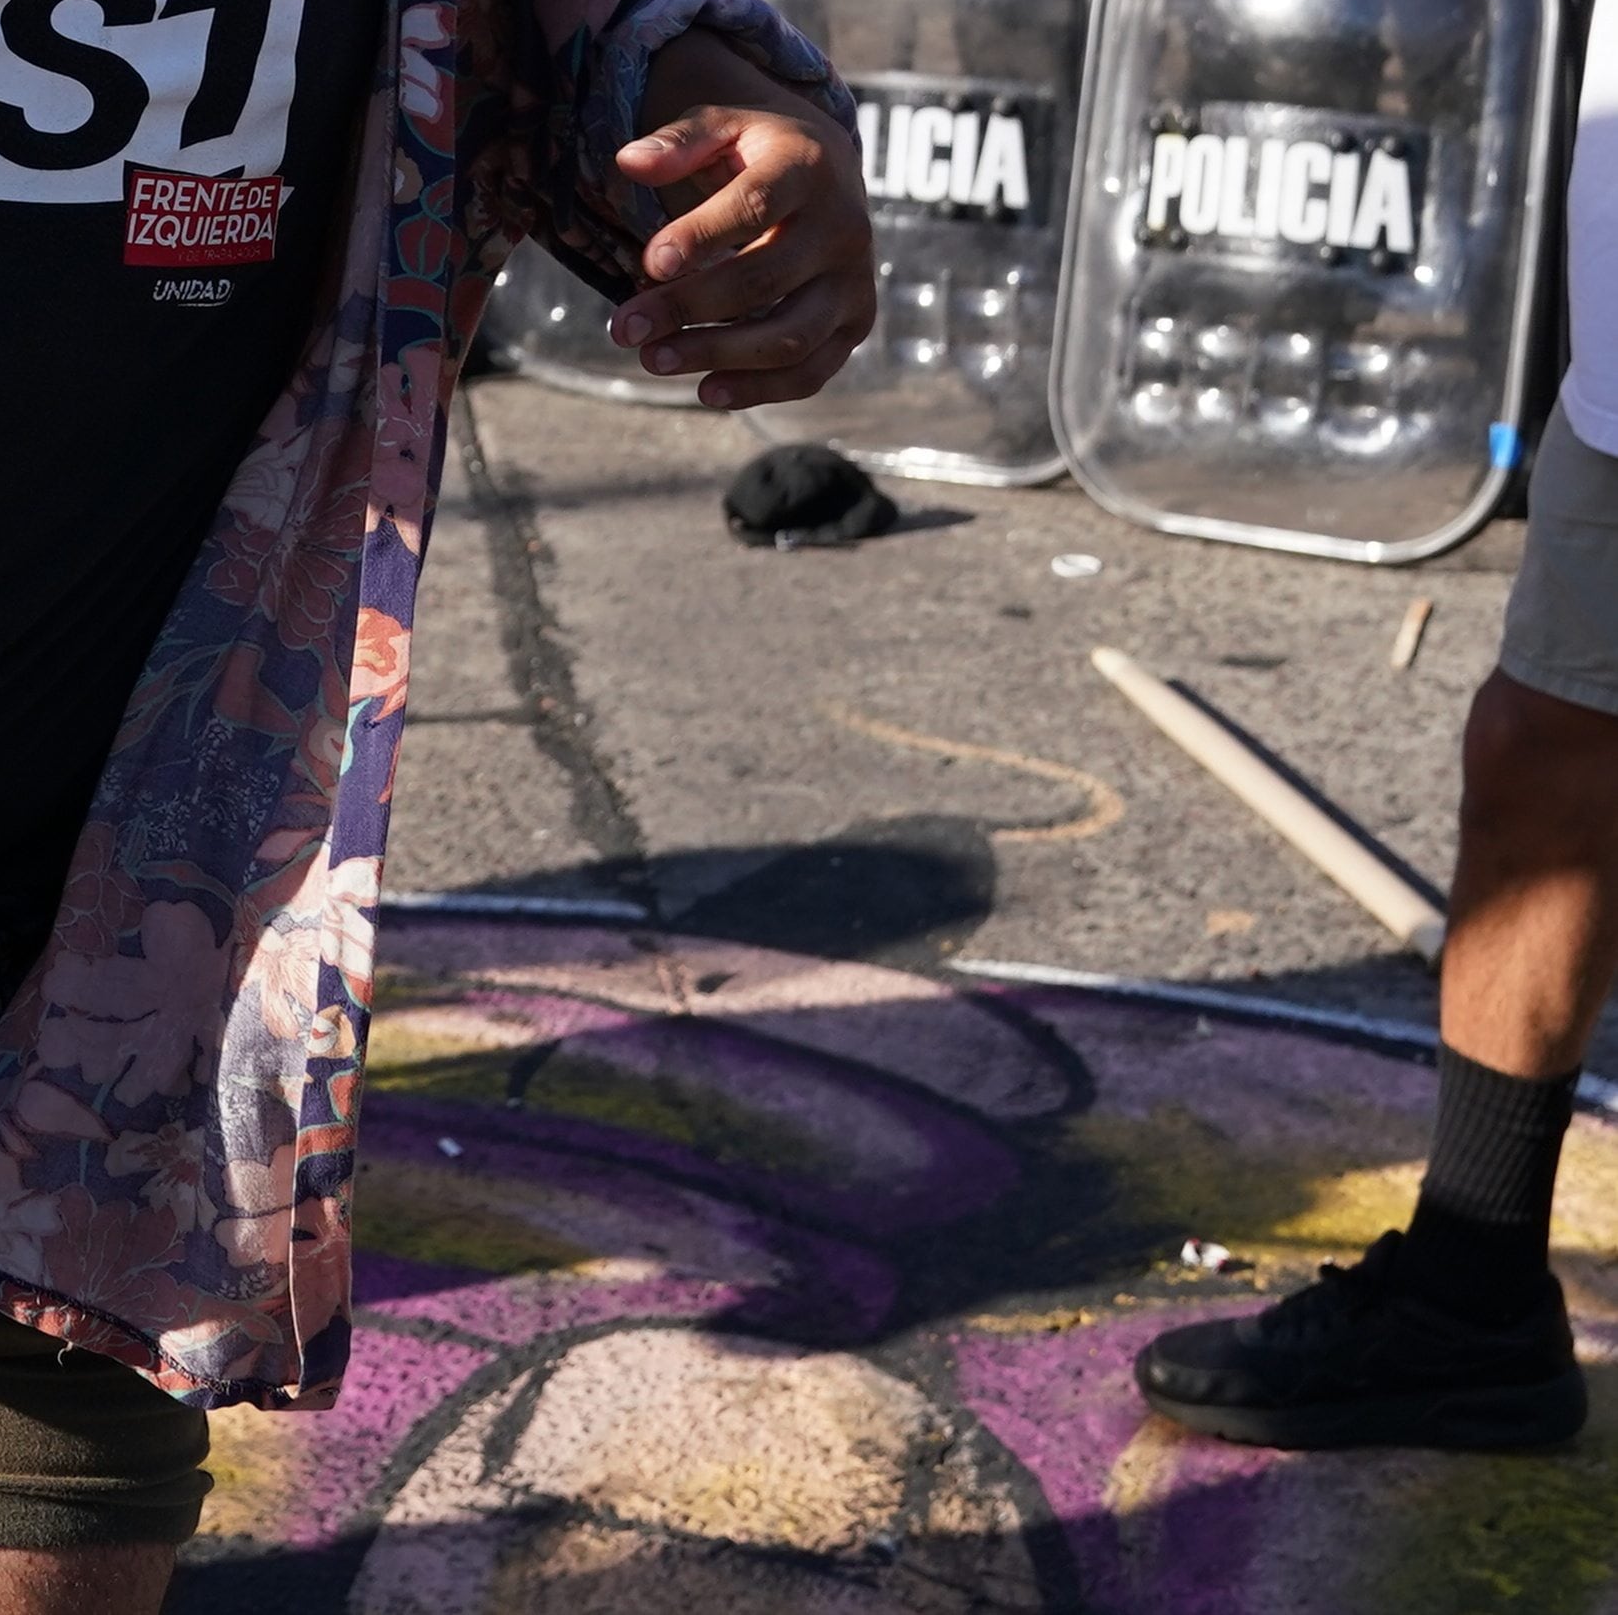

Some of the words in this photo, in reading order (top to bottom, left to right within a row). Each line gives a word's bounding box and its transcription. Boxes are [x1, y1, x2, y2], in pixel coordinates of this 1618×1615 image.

[857, 102, 1030, 210] LICIA
[132, 177, 251, 213] FRENTE
[246, 184, 276, 209] DE
[1146, 133, 1414, 253] POLICIA
[126, 212, 273, 249] IZQUIERDA
[152, 278, 233, 302] UNIDAD
